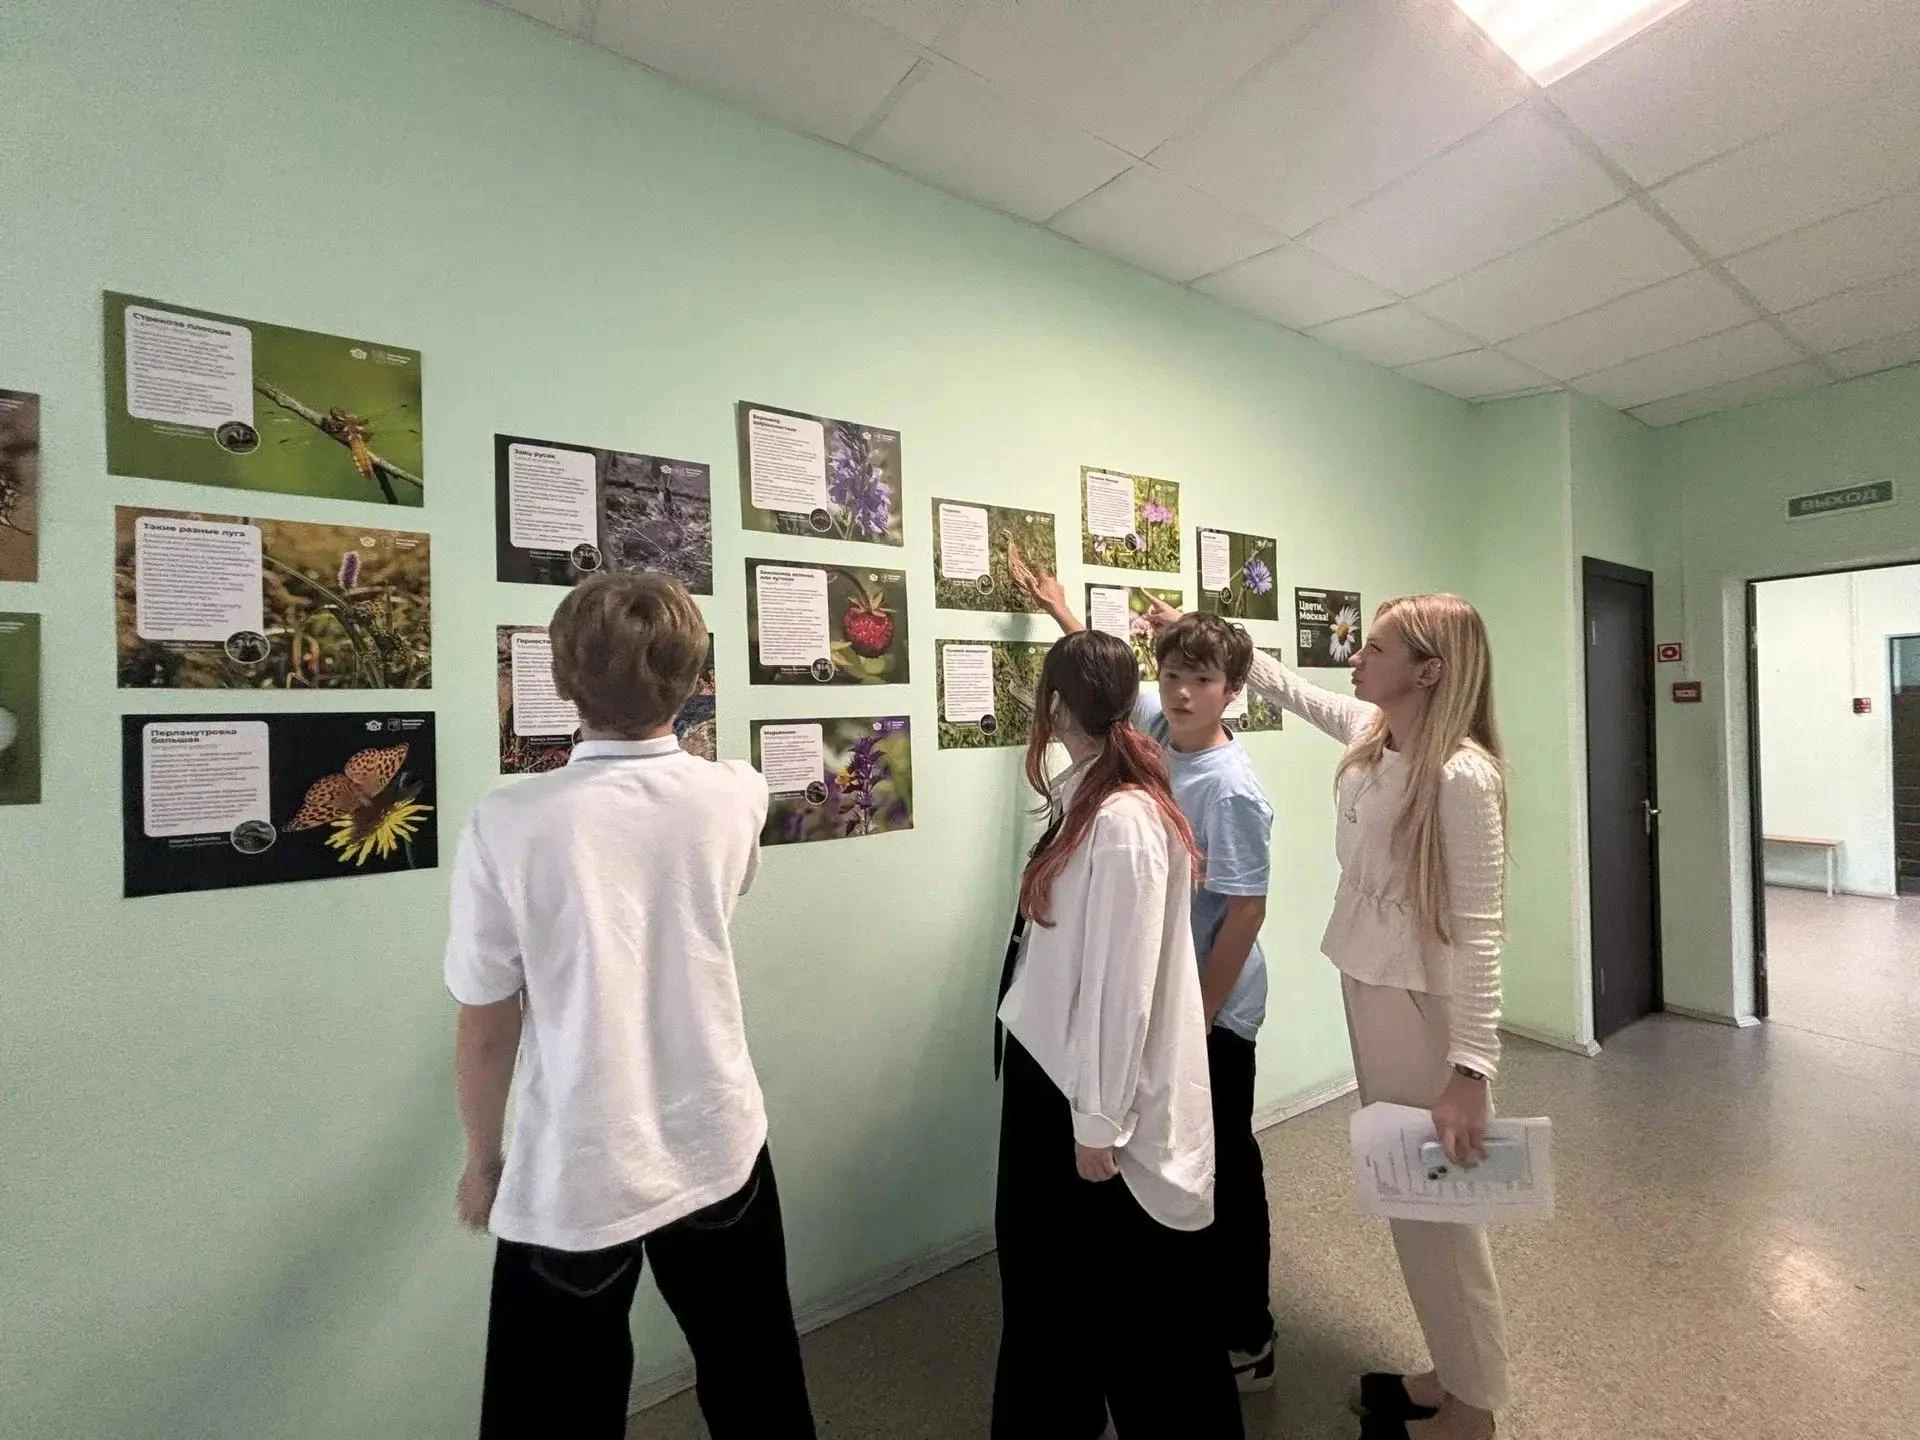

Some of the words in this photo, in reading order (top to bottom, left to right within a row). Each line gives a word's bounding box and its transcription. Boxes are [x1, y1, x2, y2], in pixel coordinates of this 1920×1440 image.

[1801, 488, 1879, 510] ВЫХОД
[144, 523, 177, 532] Такие
[180, 526, 220, 535] разные
[222, 530, 246, 538] луга
[1299, 601, 1324, 612] Цвети,
[1299, 611, 1329, 620] Москва!
[150, 729, 237, 737] Перламутровка
